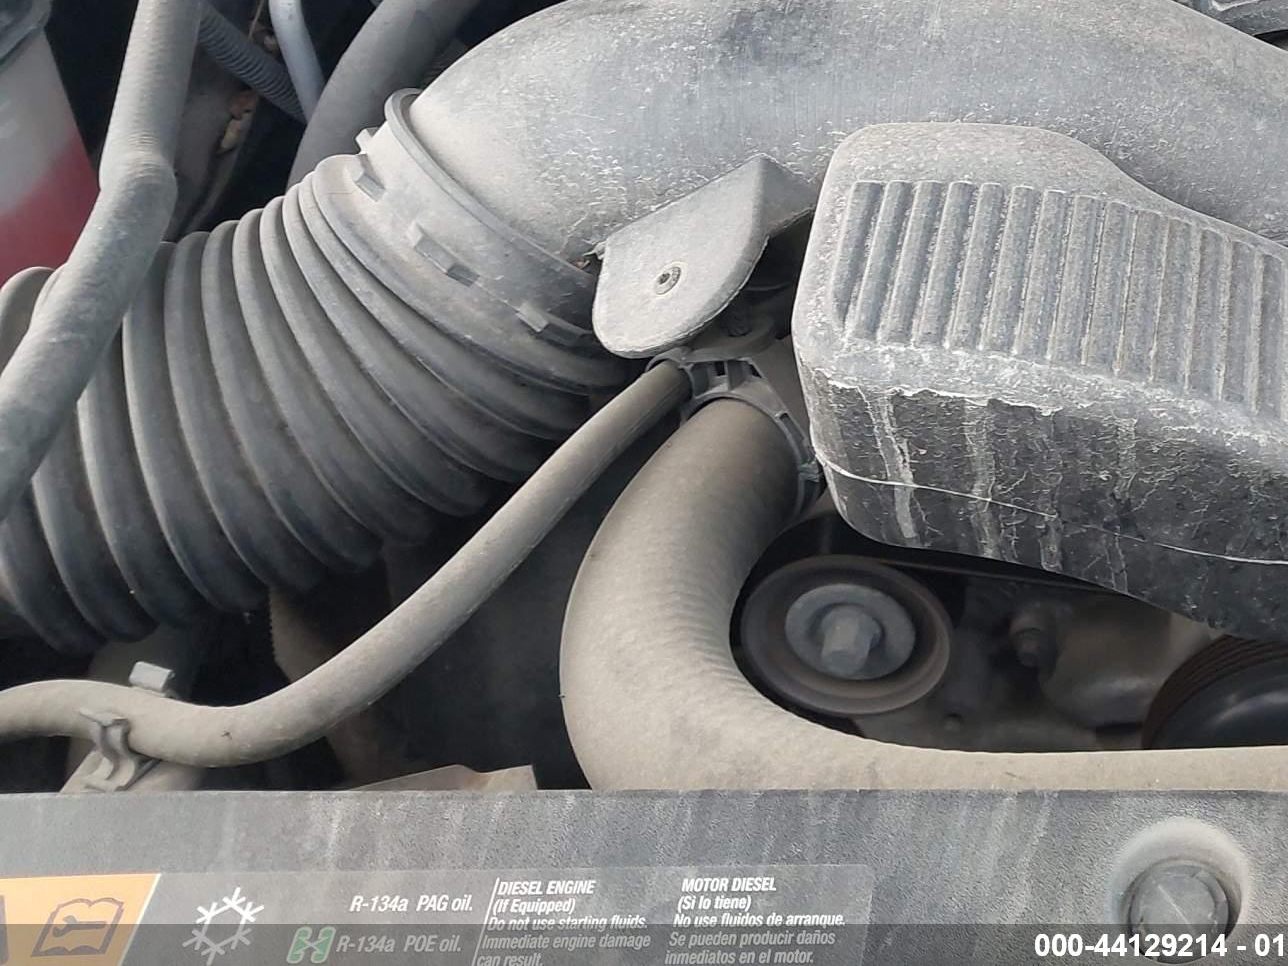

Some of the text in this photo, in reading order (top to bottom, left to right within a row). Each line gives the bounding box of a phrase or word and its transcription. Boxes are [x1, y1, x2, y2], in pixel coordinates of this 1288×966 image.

[498, 880, 597, 895] DIESEL ENGINE
[681, 877, 777, 892] MOTOR DIESEL
[350, 894, 473, 912] R-134a PAG oil.
[492, 897, 576, 915] (If Equipped)
[677, 895, 752, 912] (Si lo tiene)
[487, 914, 648, 932] Do not use starting fluids.
[673, 912, 846, 929] No use fluidos de arranque.
[336, 935, 461, 953] R-134a POE oil.
[482, 934, 652, 951] Immediate engine damage
[669, 930, 836, 948] Se pueden producir daños
[476, 952, 544, 966] can result.
[664, 950, 814, 965] inmediatos en el motor.
